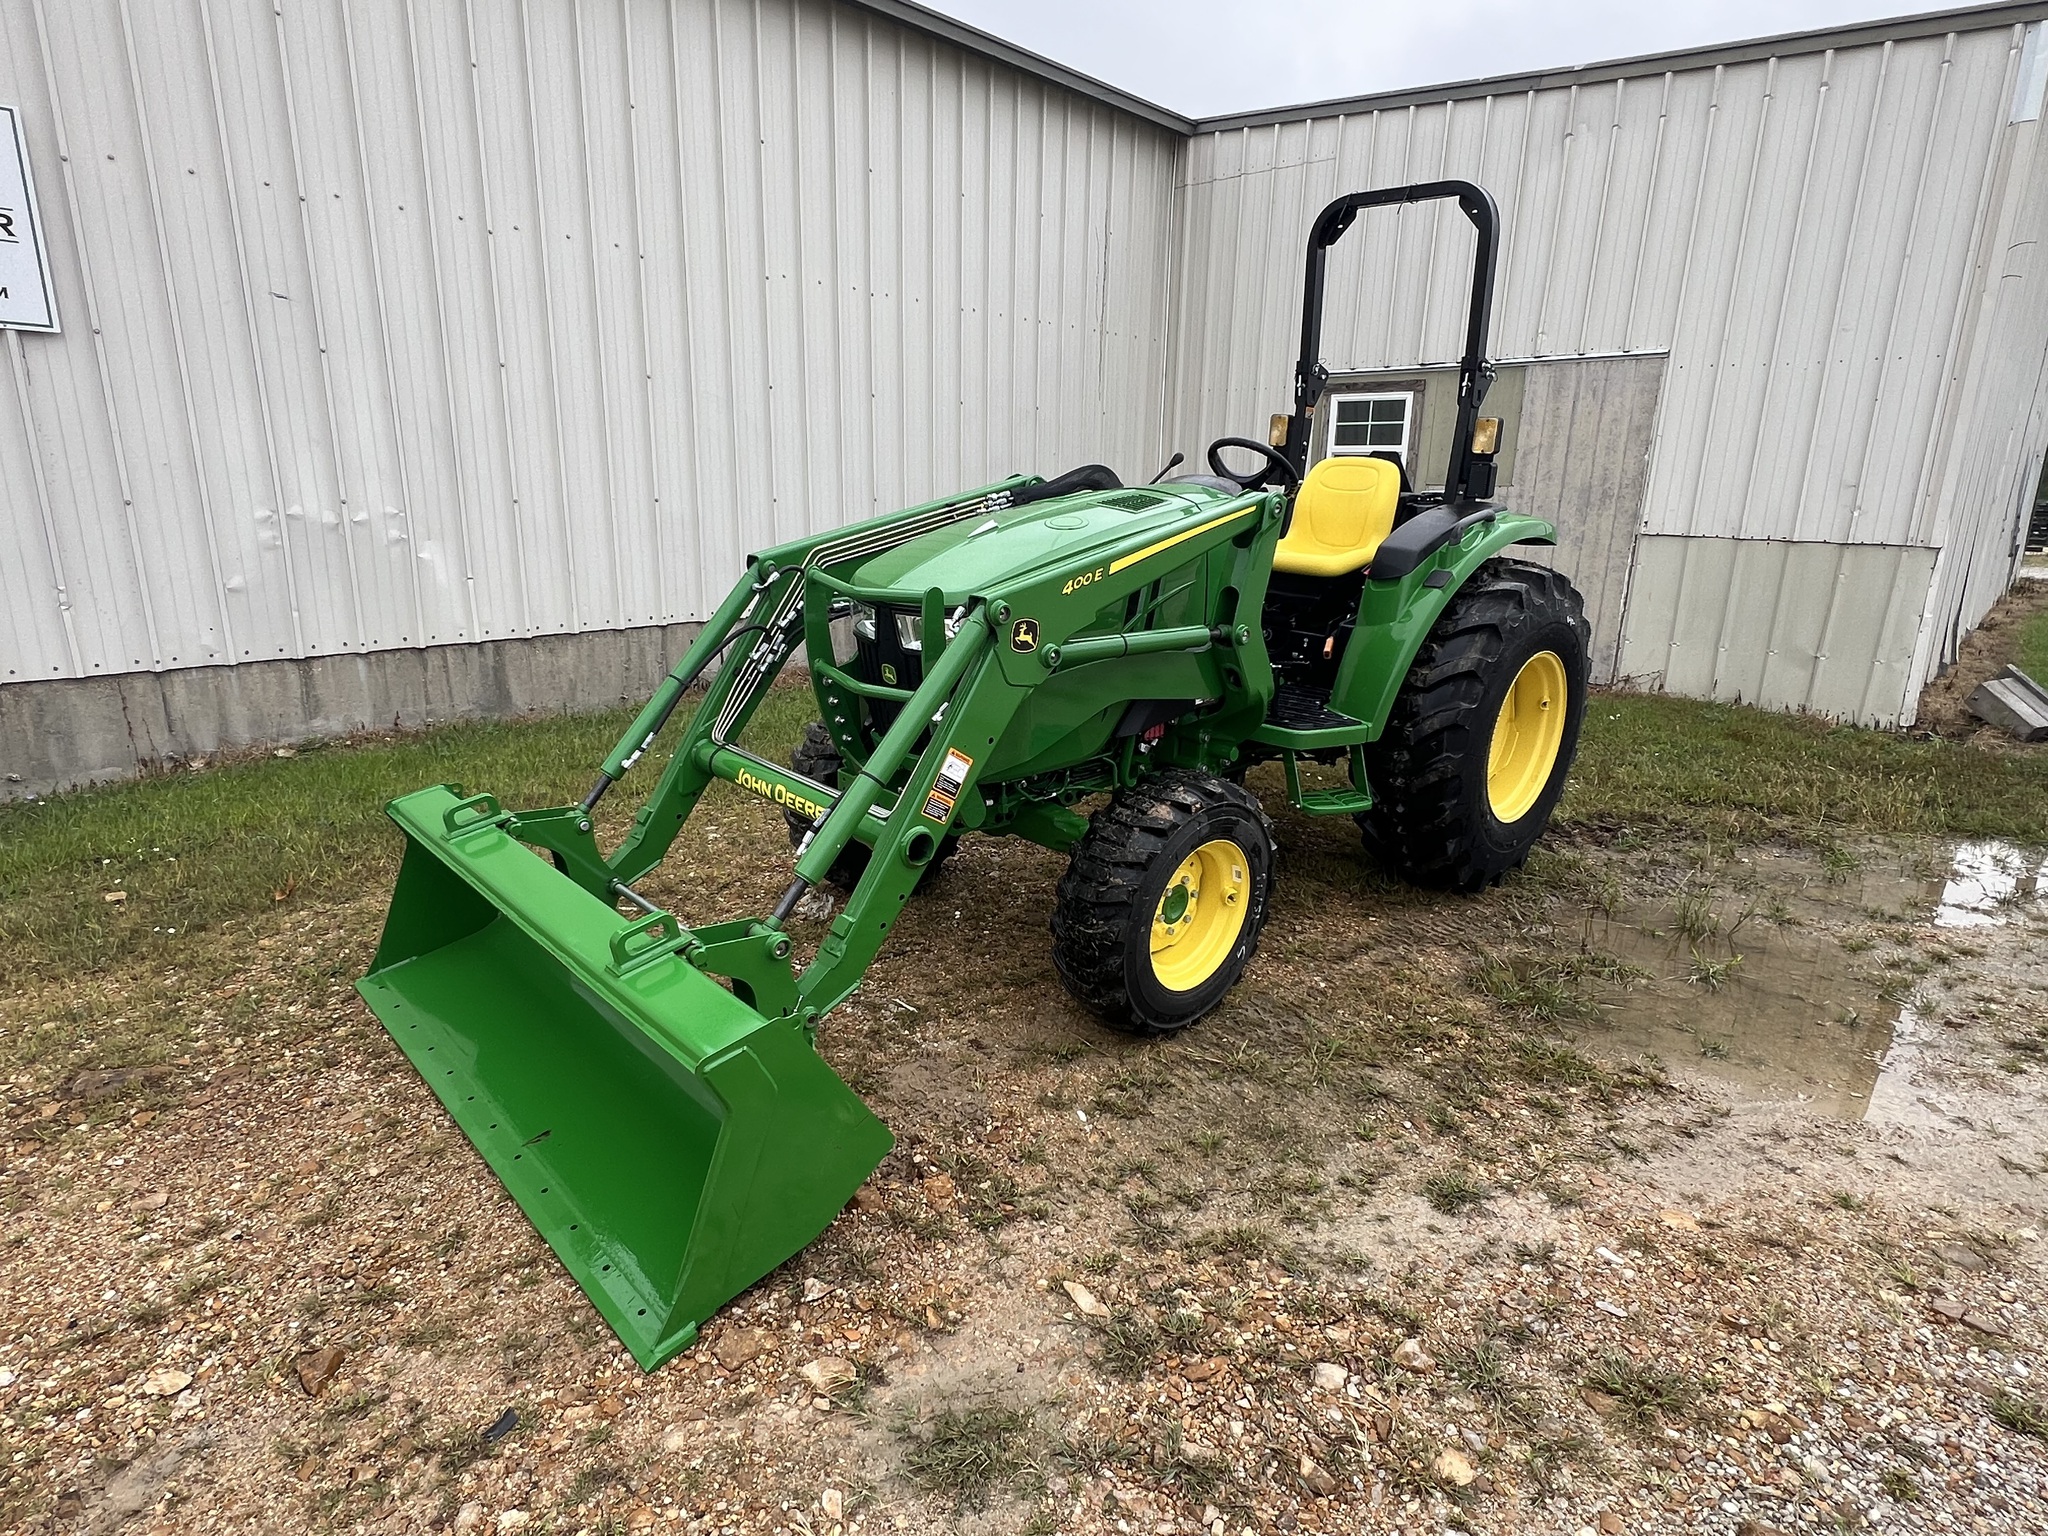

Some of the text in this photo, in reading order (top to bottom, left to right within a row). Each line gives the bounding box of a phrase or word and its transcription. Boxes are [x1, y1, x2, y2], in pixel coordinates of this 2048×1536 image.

[1061, 567, 1104, 595] 400 E
[735, 767, 773, 799] JOHN
